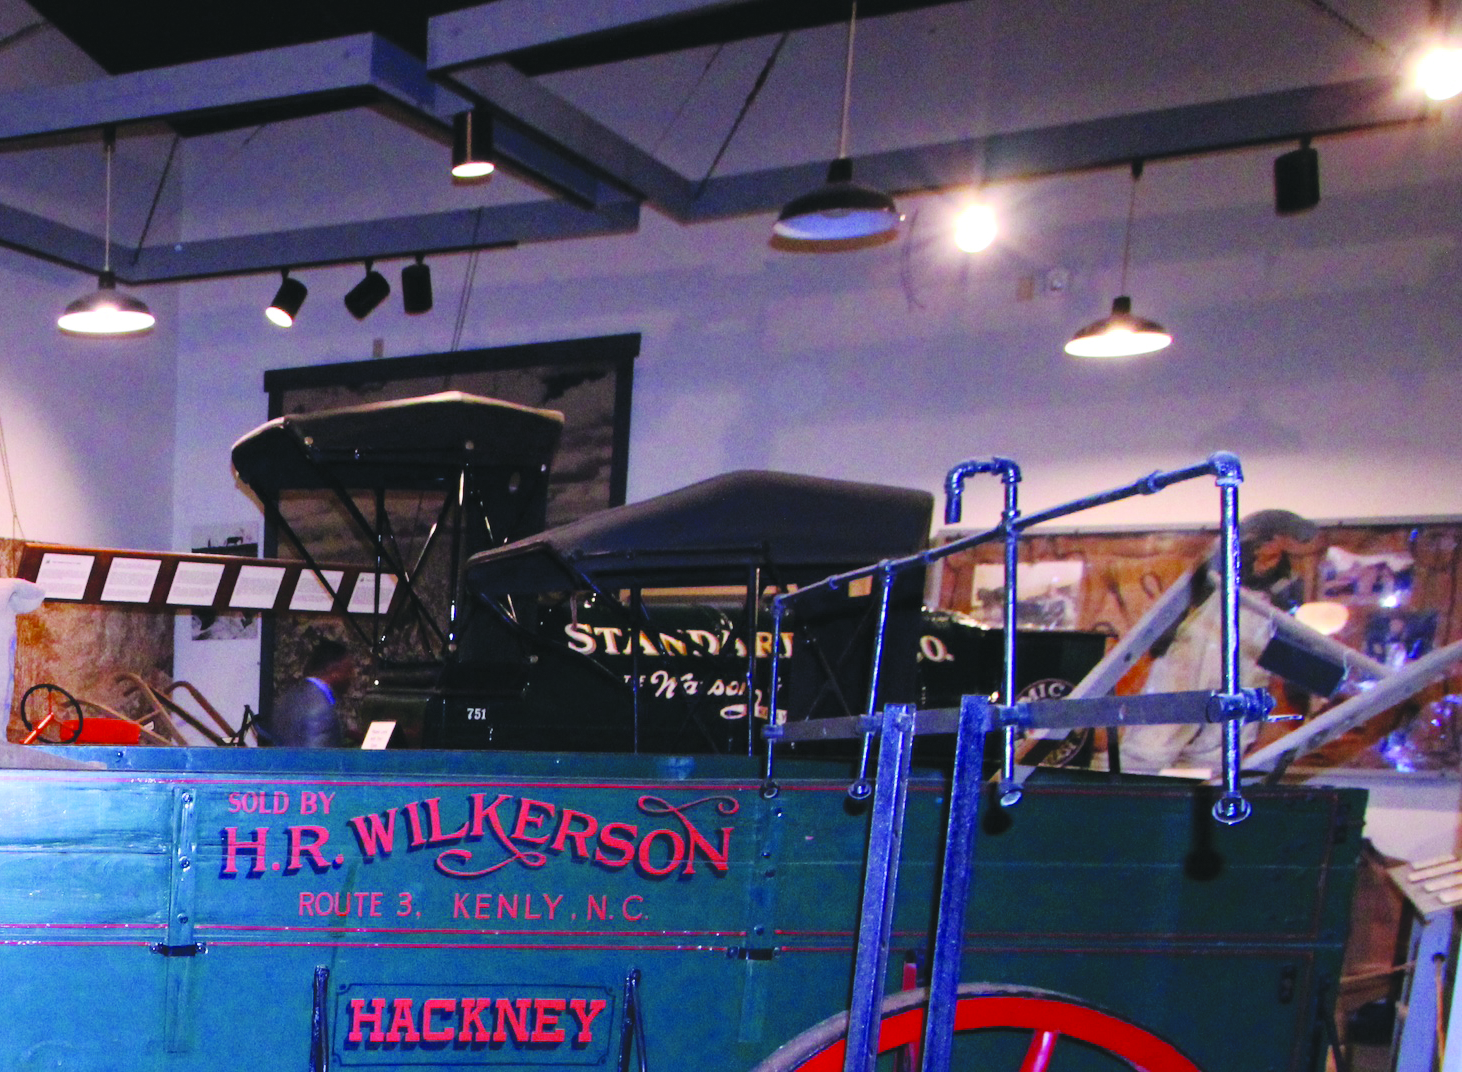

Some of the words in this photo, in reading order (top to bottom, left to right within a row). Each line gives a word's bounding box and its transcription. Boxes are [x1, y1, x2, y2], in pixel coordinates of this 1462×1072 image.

[916, 634, 955, 663] O.
[467, 707, 487, 720] 751
[227, 792, 289, 814] SOLD
[300, 791, 335, 815] BY
[349, 793, 739, 877] WILKERSON
[298, 891, 383, 917] ROUTE
[348, 998, 606, 1042] HACKNEY
